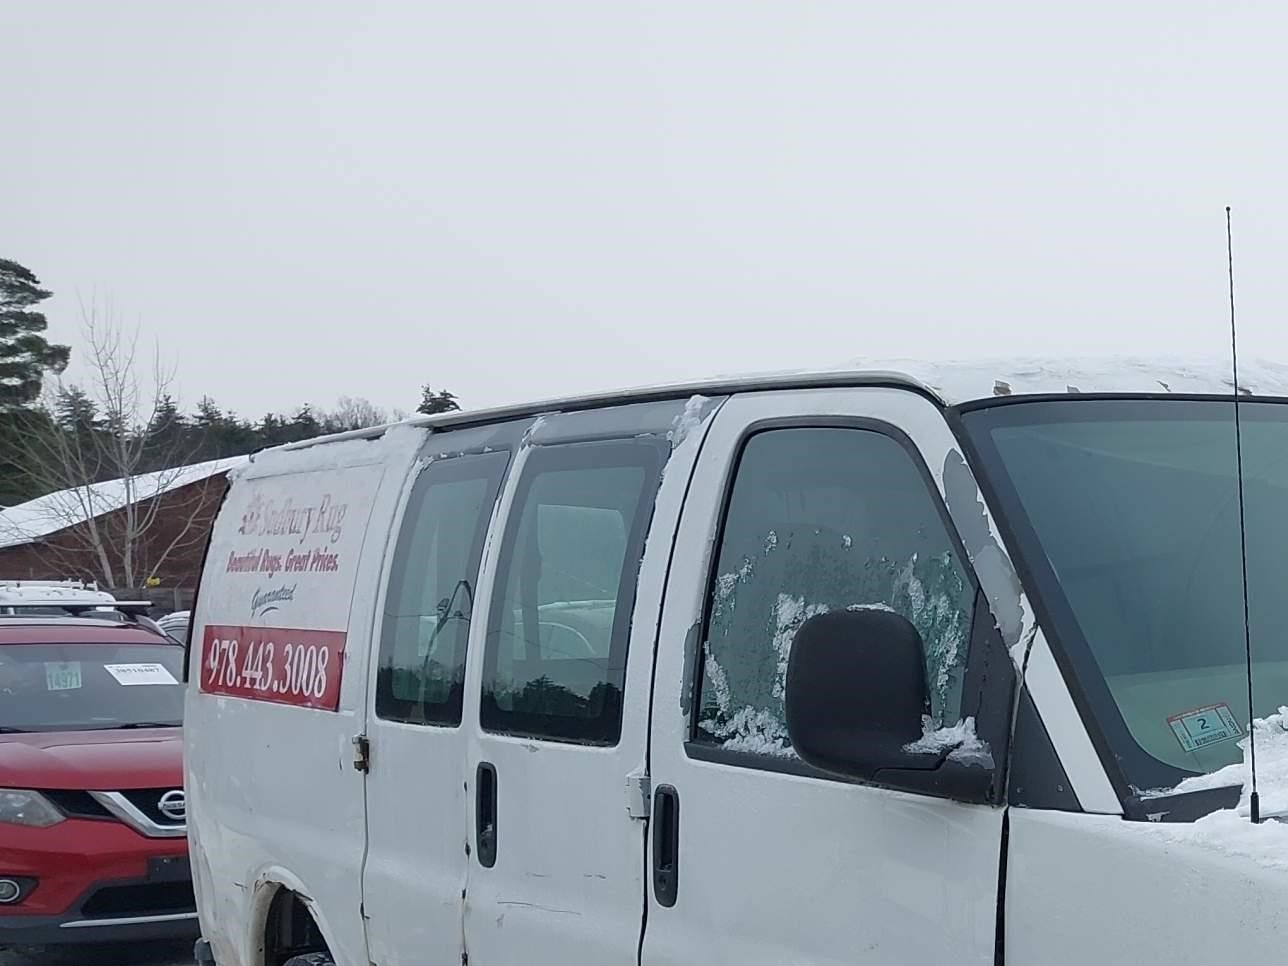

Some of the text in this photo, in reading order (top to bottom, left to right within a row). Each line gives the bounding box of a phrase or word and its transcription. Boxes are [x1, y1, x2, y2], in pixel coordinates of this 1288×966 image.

[312, 493, 349, 543] Rug
[284, 547, 312, 572] Great
[309, 546, 339, 572] Prices.
[208, 638, 329, 698] 978.443.3008
[1196, 718, 1210, 730] 2
